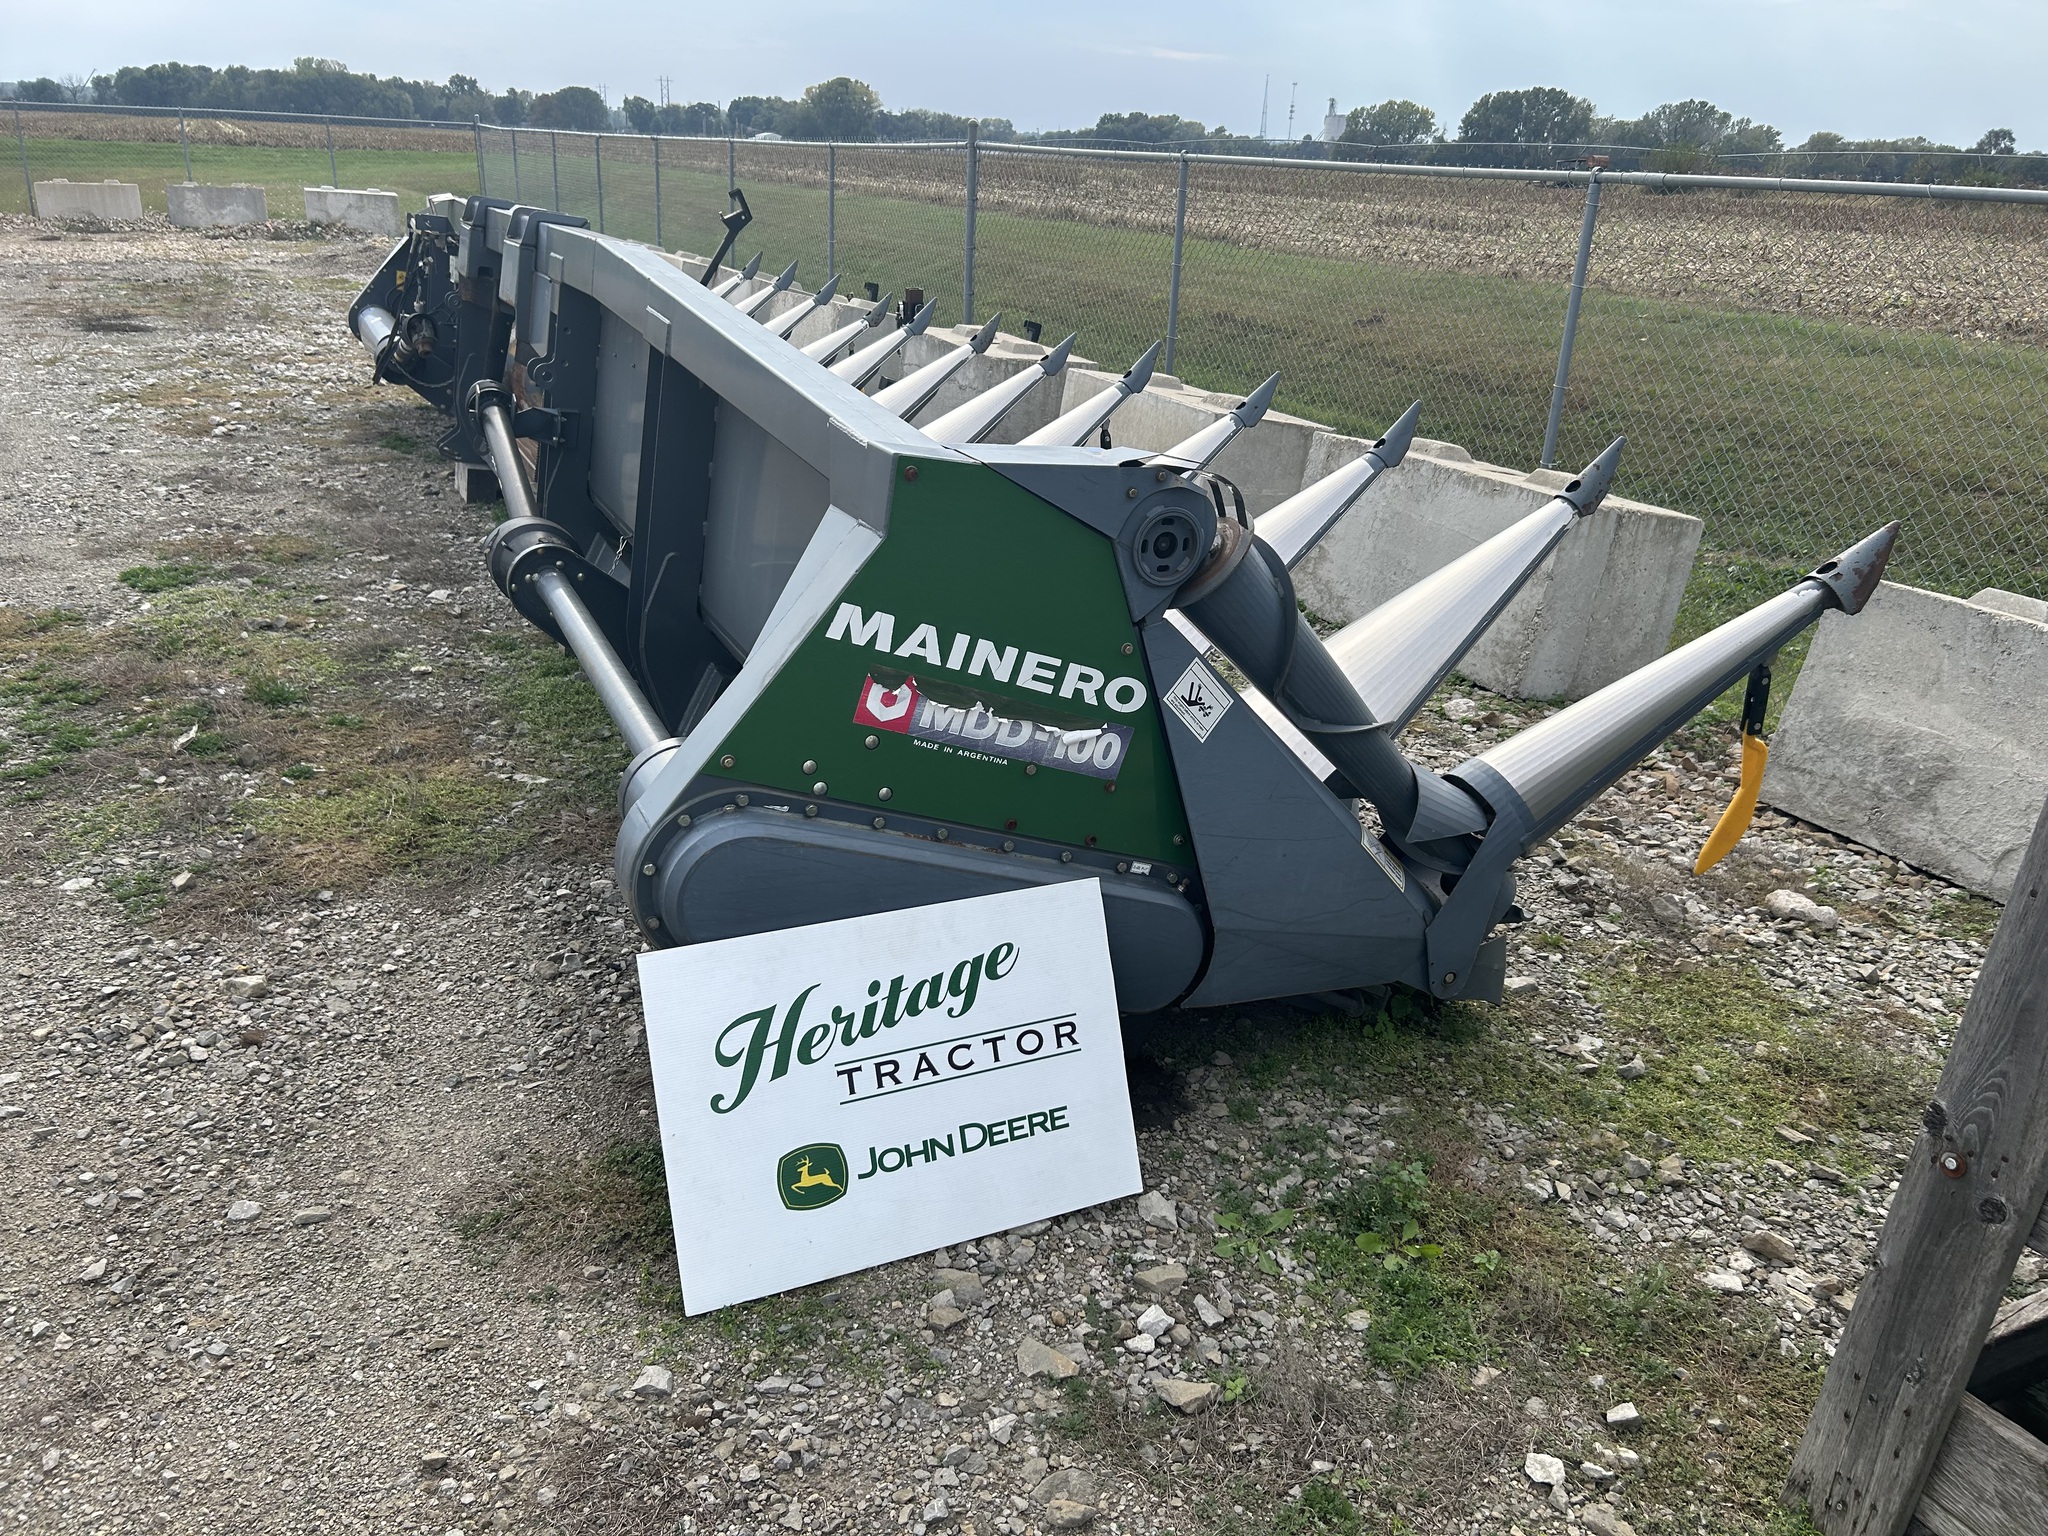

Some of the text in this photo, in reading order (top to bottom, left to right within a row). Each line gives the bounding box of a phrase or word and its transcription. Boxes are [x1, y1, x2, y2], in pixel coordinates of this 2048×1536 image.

[825, 602, 1147, 713] MAINERO
[913, 739, 1009, 766] MADE IN ARGENTINA
[710, 942, 1020, 1115] Heritage
[836, 1021, 1080, 1096] TRACTOR
[858, 1106, 1070, 1180] JOHN DEERE
